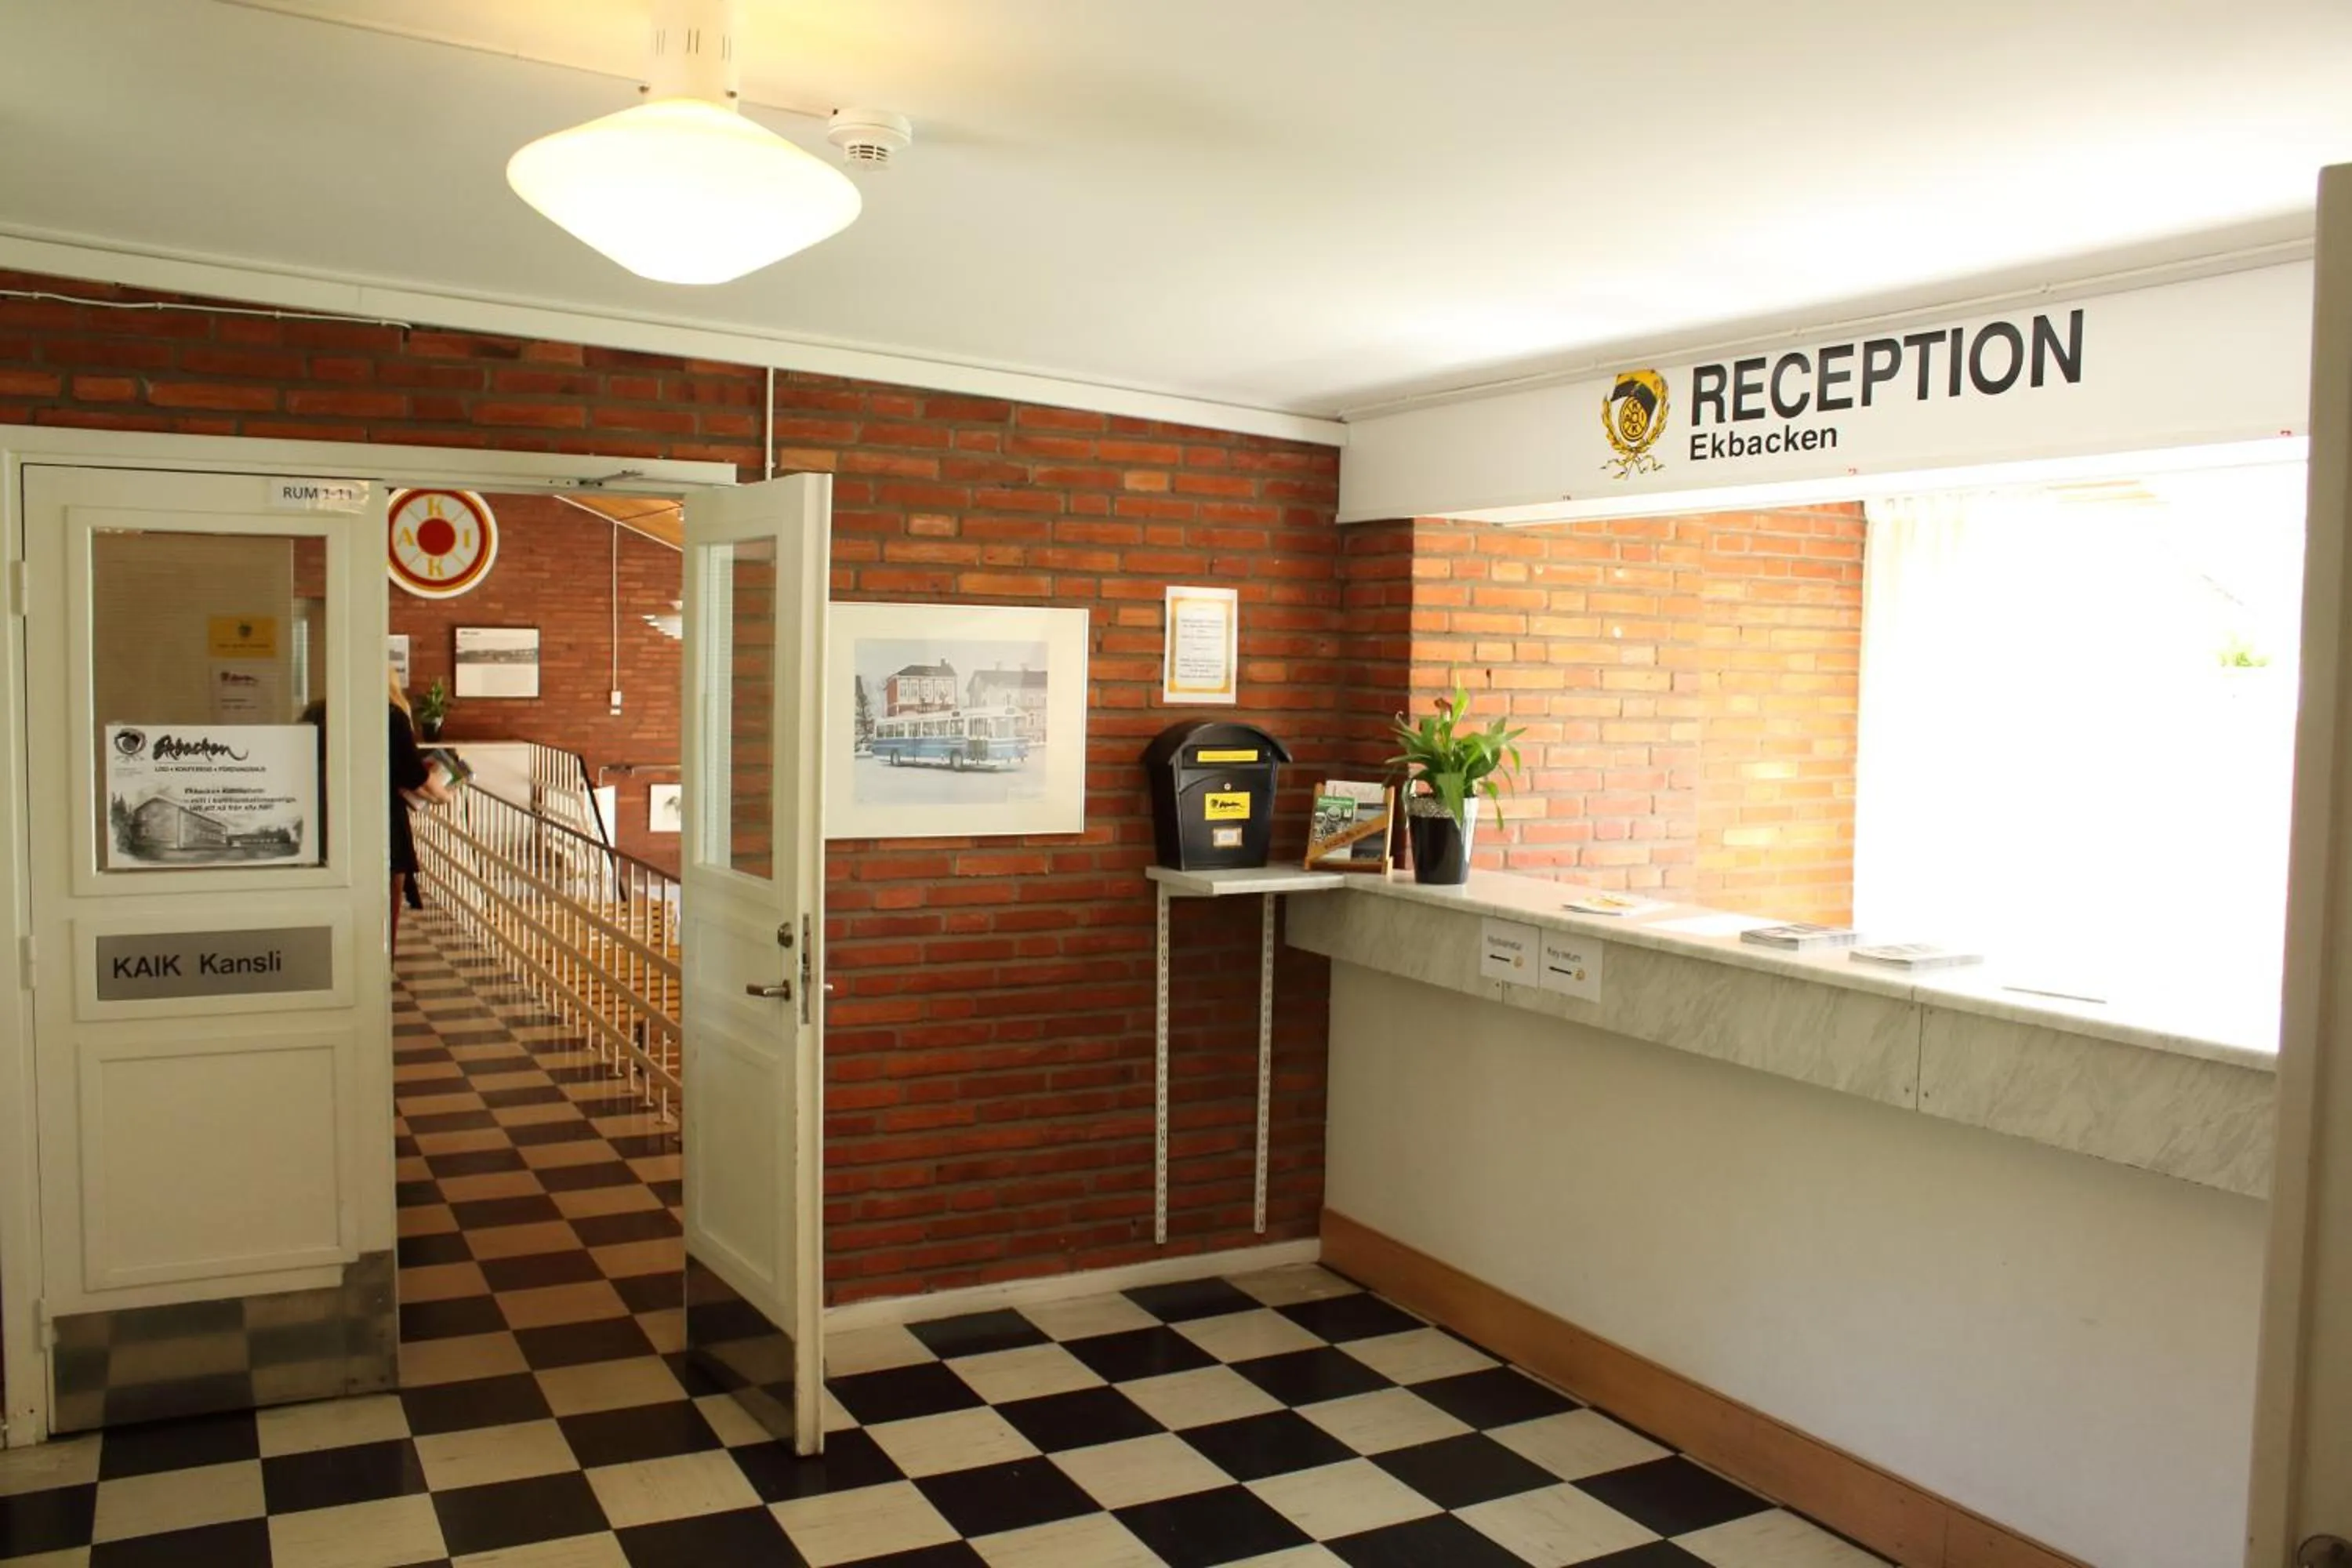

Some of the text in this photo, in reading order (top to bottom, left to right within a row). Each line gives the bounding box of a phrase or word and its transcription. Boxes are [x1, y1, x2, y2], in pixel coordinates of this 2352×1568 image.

[1691, 309, 2084, 426] RECEPTION
[1690, 425, 1838, 461] Ekbacken
[283, 487, 318, 499] RUM
[114, 950, 281, 979] KAIK Kansli
